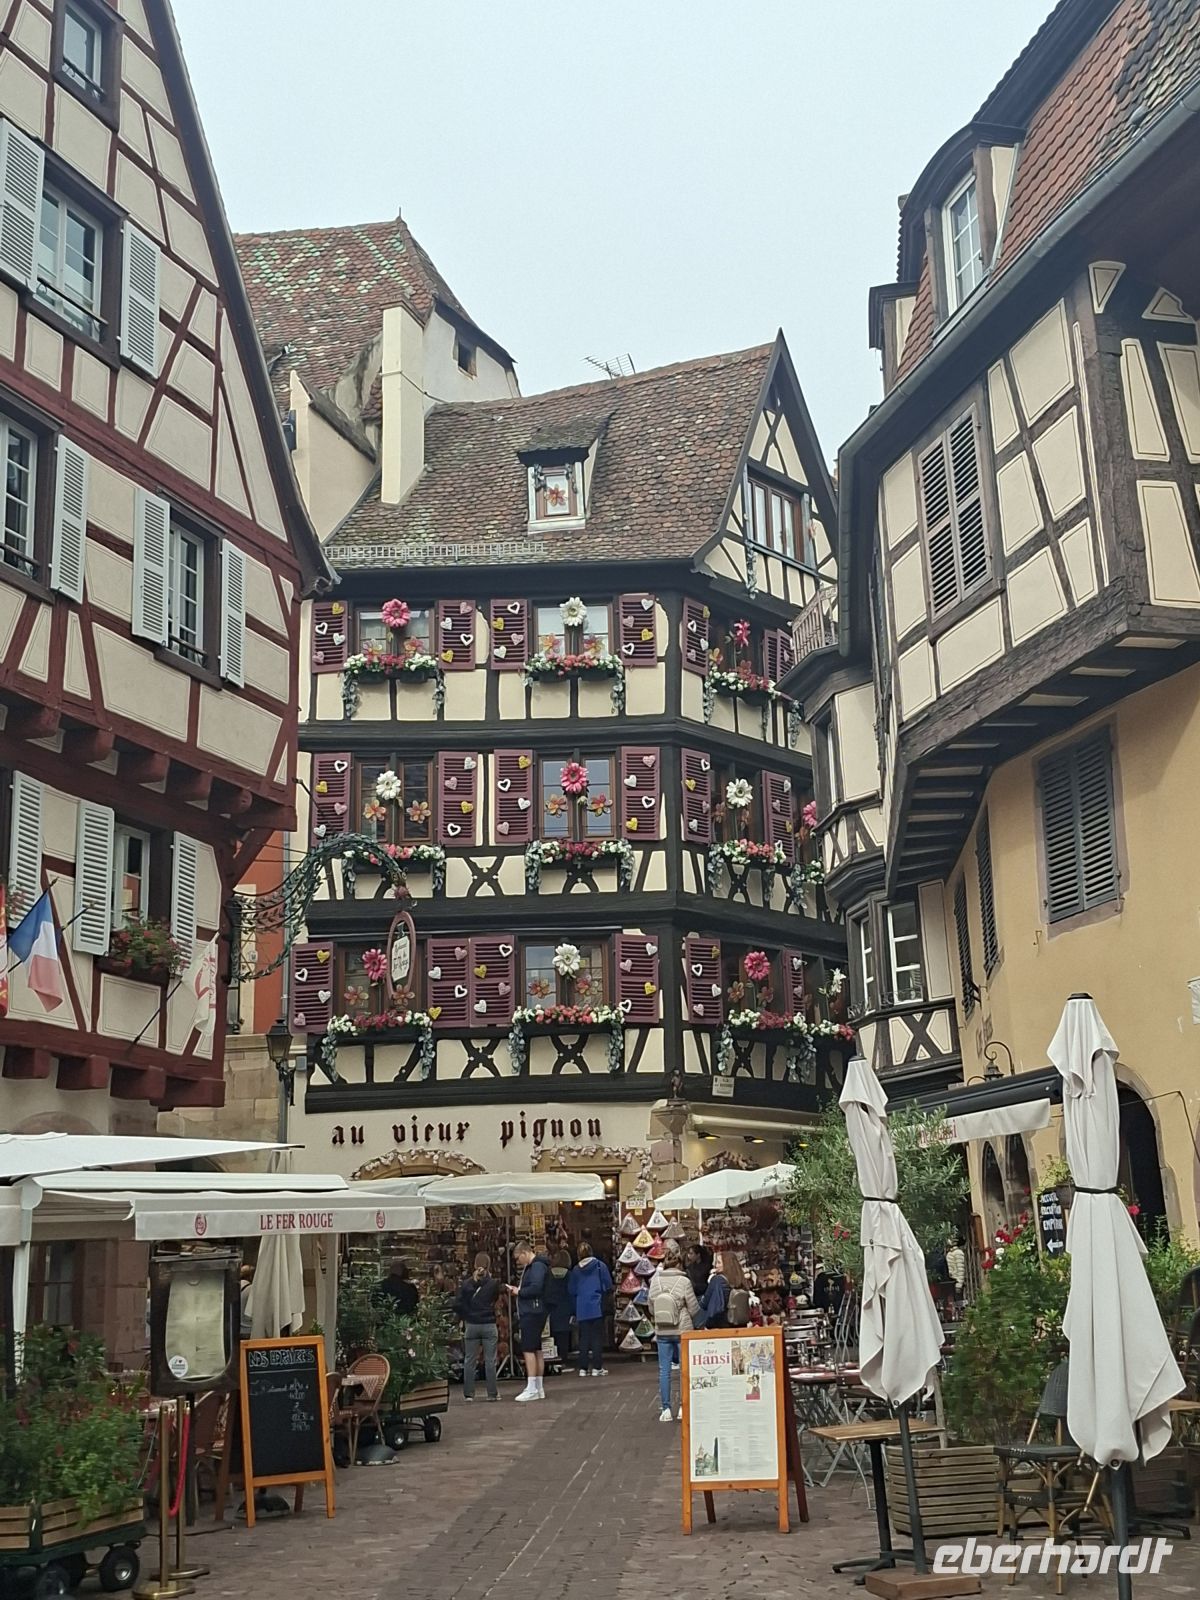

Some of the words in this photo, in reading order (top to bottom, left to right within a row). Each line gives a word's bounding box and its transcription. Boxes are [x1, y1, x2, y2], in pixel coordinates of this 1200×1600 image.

[331, 1124, 365, 1145] au
[392, 1115, 470, 1144] vieux
[500, 1110, 602, 1149] pignon
[260, 1214, 274, 1230] LE
[276, 1213, 296, 1229] FER
[299, 1212, 333, 1229] ROUGE
[692, 1352, 730, 1366] Hansi
